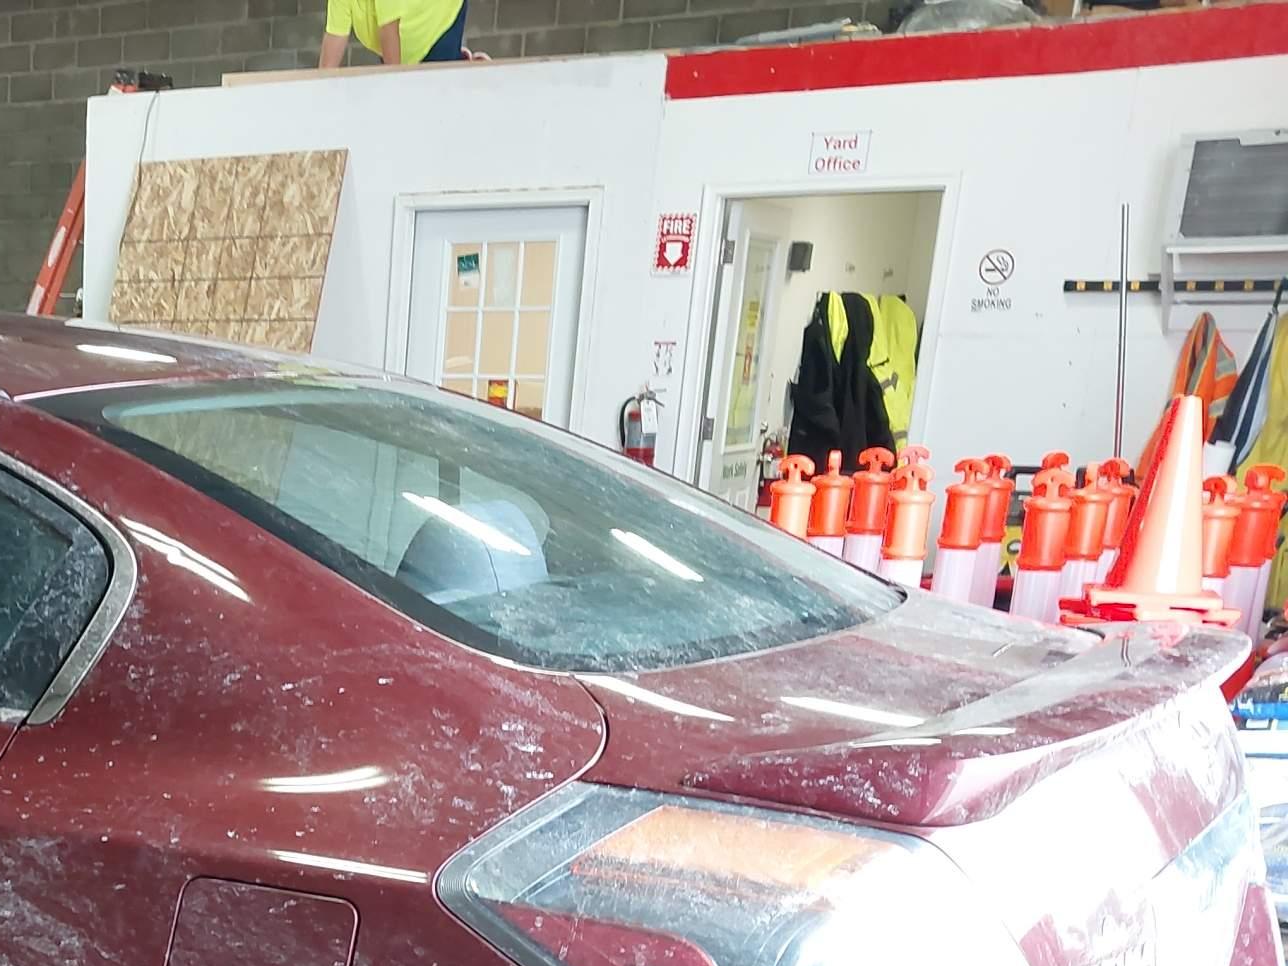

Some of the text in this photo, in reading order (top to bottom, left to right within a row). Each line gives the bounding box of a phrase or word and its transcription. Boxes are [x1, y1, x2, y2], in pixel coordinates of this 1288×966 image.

[824, 133, 858, 151] Yard
[815, 155, 861, 173] Office
[663, 219, 692, 235] FIRE
[986, 287, 1000, 298] NO
[971, 297, 1012, 311] SMOKING
